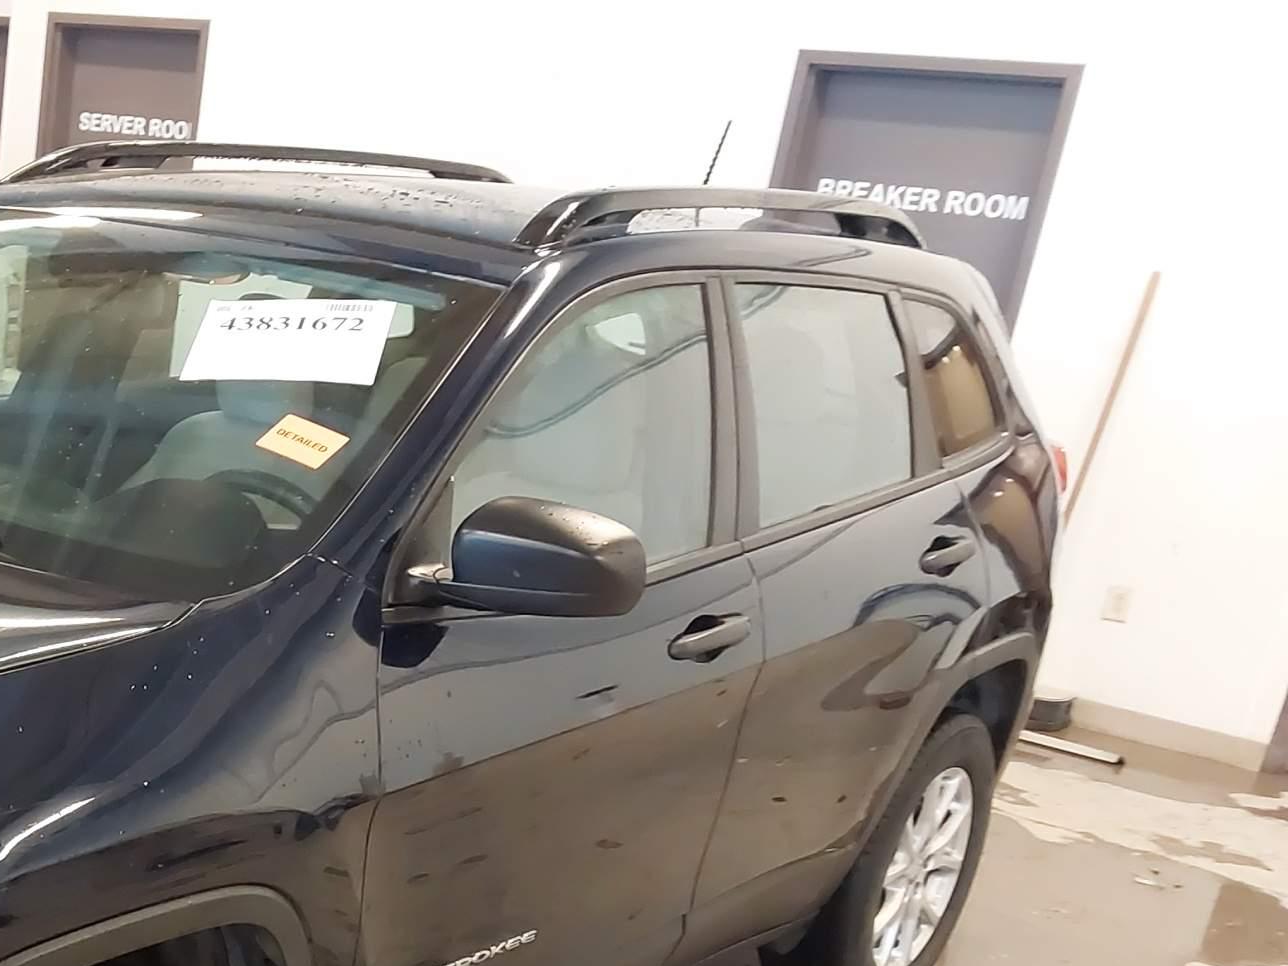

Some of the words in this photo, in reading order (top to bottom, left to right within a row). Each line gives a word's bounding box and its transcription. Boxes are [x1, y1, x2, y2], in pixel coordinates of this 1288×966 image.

[78, 112, 146, 135] SERVER
[148, 119, 192, 139] ROO
[816, 178, 941, 212] BREAKER
[943, 190, 1030, 220] ROOM
[220, 316, 365, 331] 43831672
[276, 428, 329, 453] DETAILED
